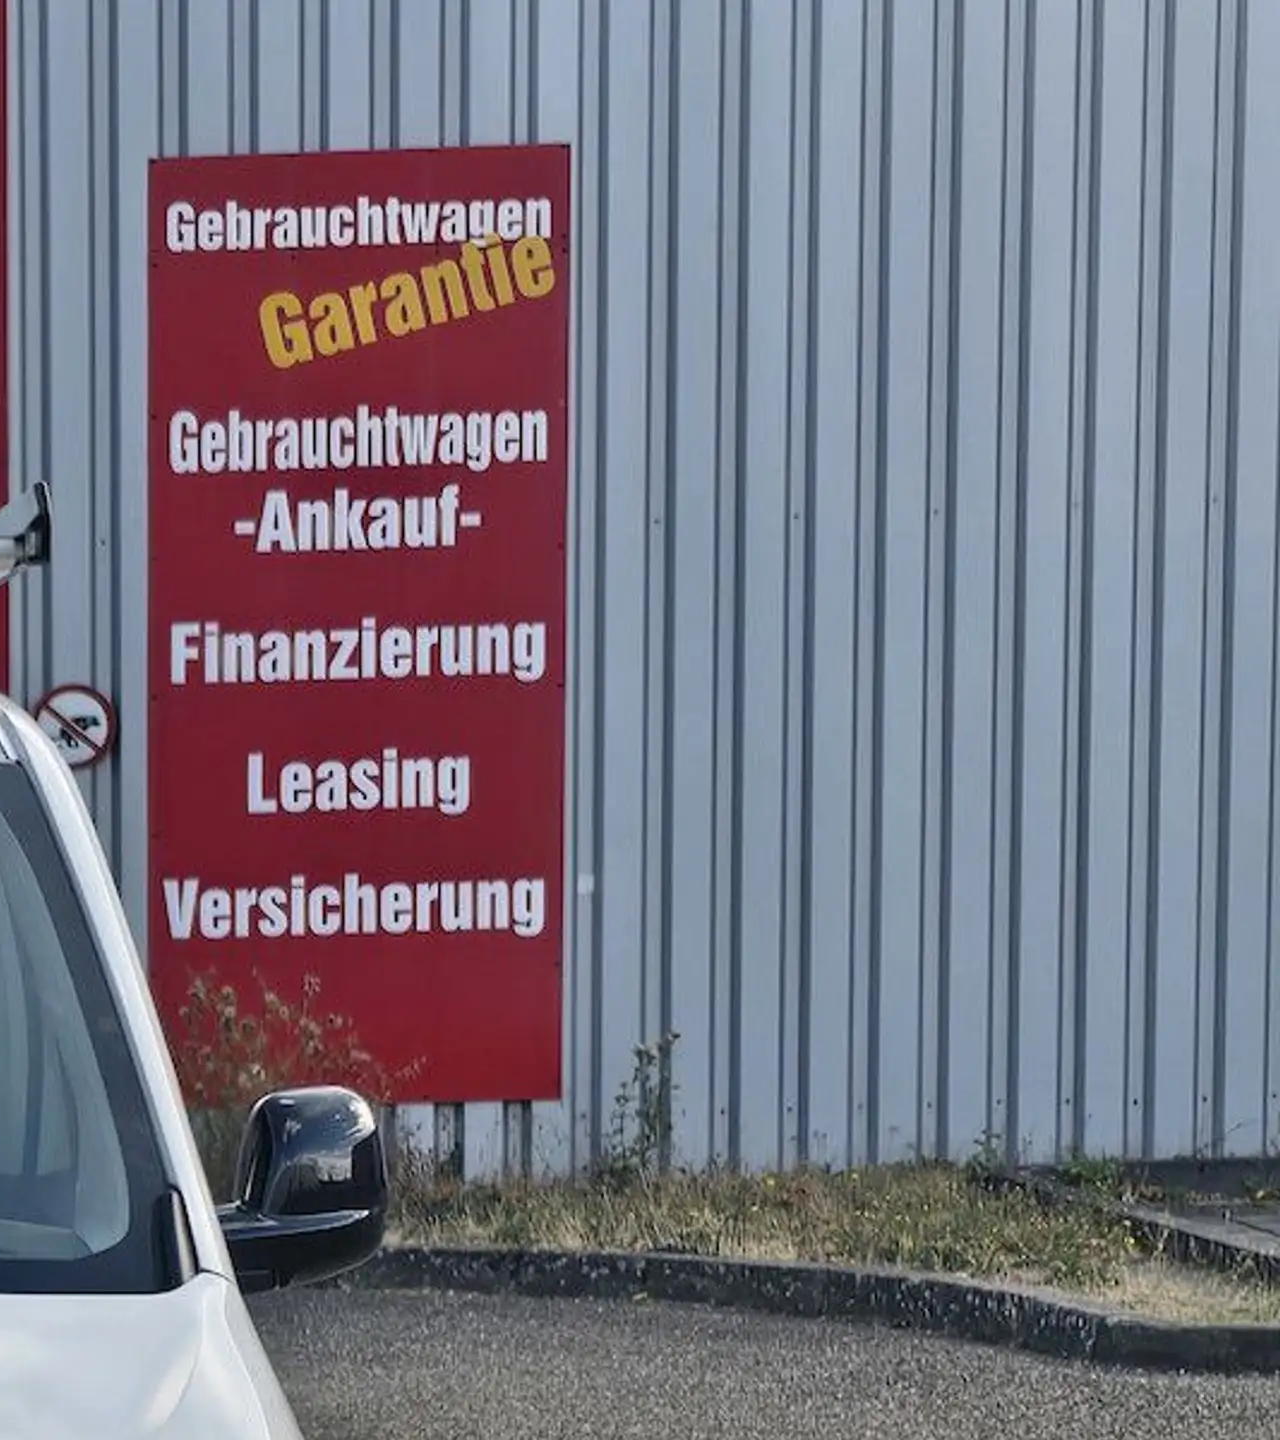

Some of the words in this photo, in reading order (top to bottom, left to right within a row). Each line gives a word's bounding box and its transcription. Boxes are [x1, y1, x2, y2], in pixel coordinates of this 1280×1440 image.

[166, 197, 552, 252] Gebrauchtwagen
[259, 232, 556, 369] Garantie
[169, 405, 548, 474] Gebrauchtwagen
[234, 485, 481, 553] -Ankauf-
[170, 617, 546, 685] Finanzierung
[247, 748, 470, 815] Leasing
[163, 874, 545, 939] Versicherung
